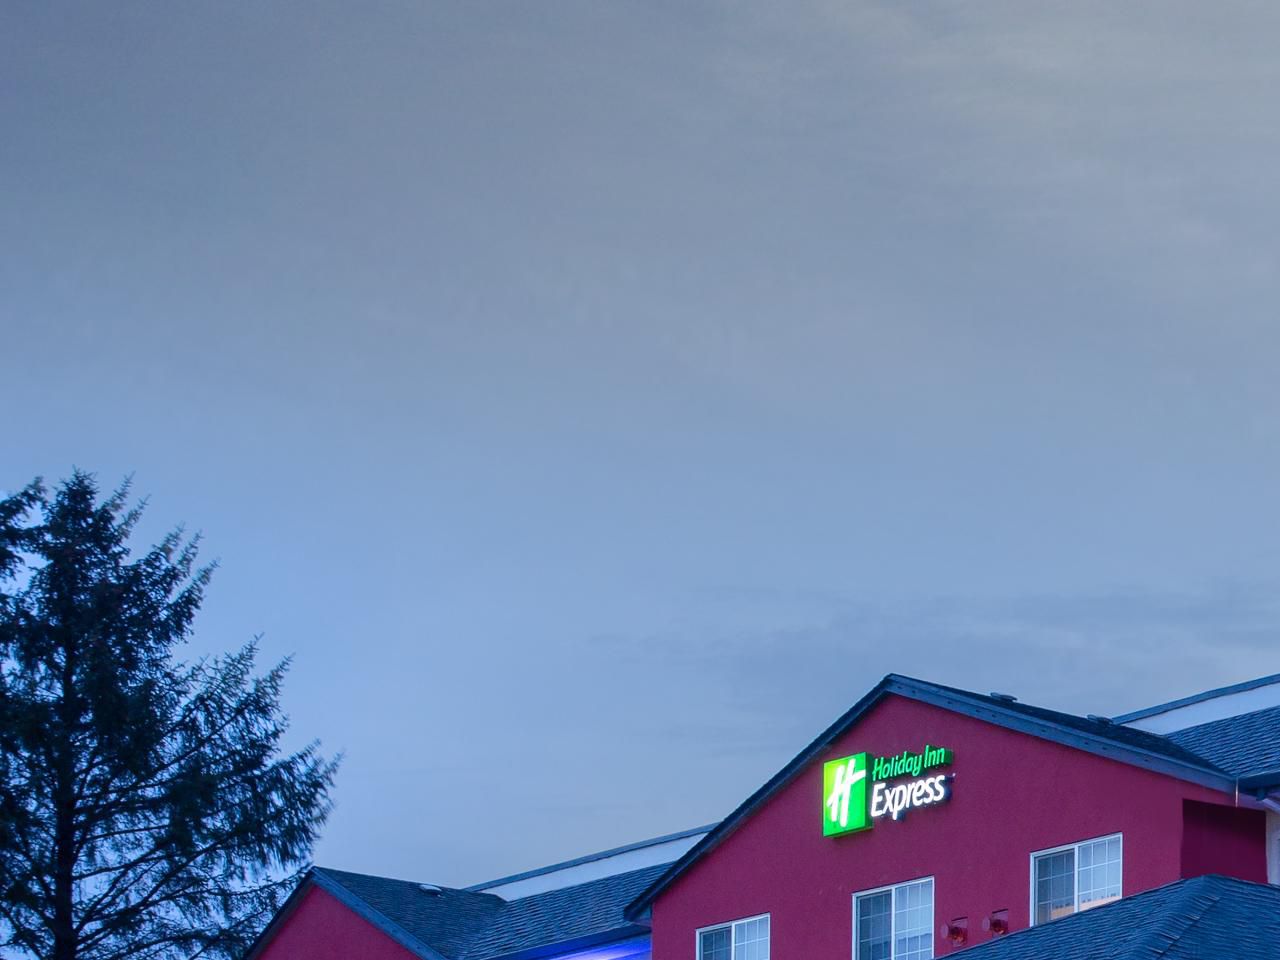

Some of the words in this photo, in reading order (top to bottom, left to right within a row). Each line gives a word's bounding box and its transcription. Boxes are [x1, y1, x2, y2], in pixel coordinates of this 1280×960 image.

[872, 751, 922, 781] Holiday
[924, 745, 946, 768] Inn
[870, 774, 946, 820] Express
